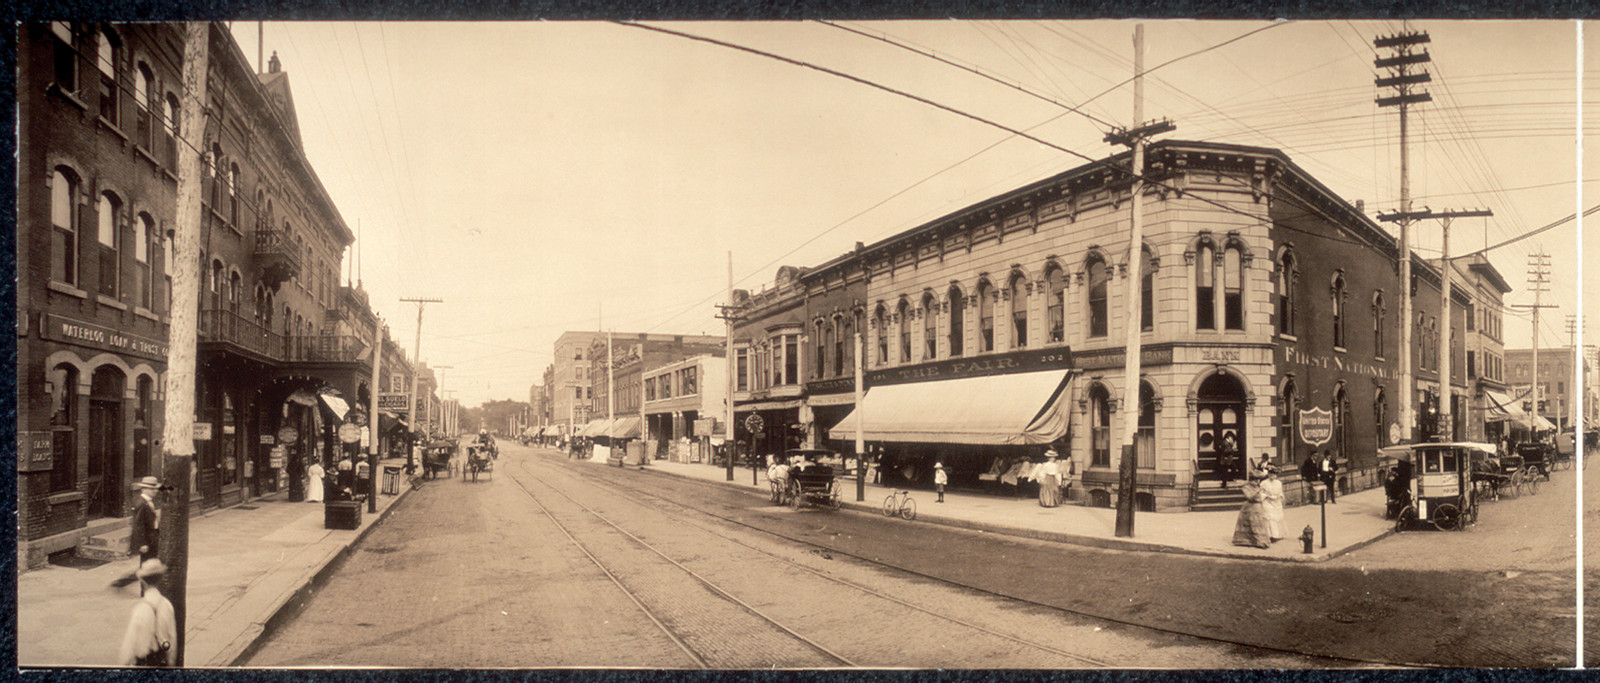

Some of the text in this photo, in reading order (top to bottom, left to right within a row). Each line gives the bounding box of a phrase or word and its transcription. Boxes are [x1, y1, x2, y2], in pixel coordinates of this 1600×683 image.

[62, 323, 105, 343] WATERLOO
[109, 335, 128, 348] LOAN
[140, 341, 159, 355] TRUST
[1144, 350, 1172, 361] BANK
[1202, 351, 1241, 361] BANK
[1285, 346, 1329, 369] FIRST
[1333, 356, 1390, 378] NATIONAL
[899, 366, 940, 379] THE
[952, 357, 1021, 374] FAIR.
[1041, 354, 1064, 363] 202
[1302, 416, 1330, 425] UNITED STATES
